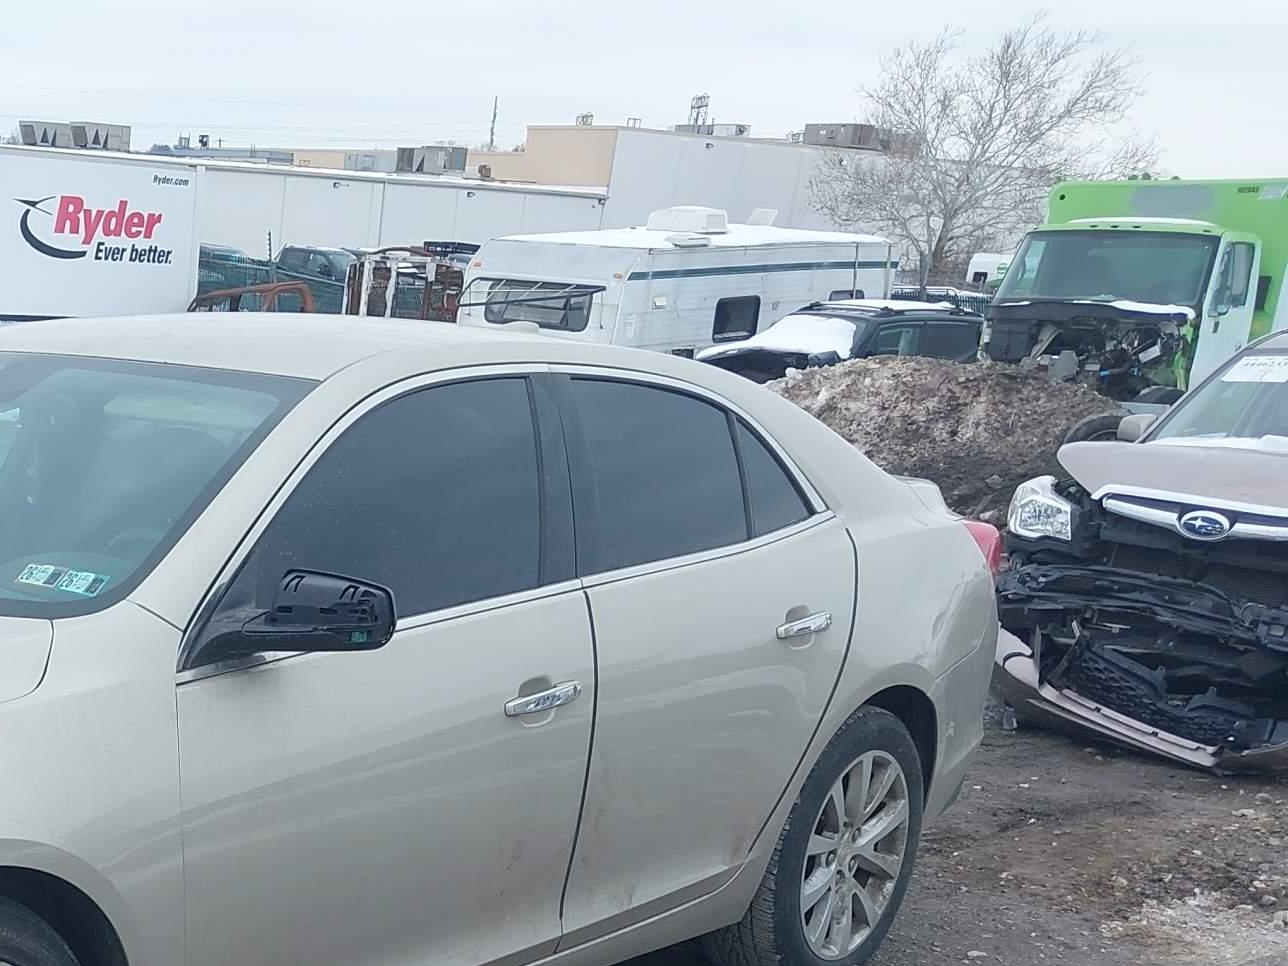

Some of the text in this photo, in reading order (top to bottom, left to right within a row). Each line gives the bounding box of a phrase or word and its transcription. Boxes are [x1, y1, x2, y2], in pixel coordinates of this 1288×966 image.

[153, 174, 189, 186] Ryder.com
[54, 195, 162, 245] Ryder
[94, 242, 172, 264] Ever better.
[20, 565, 39, 581] 26
[59, 572, 79, 588] 26
